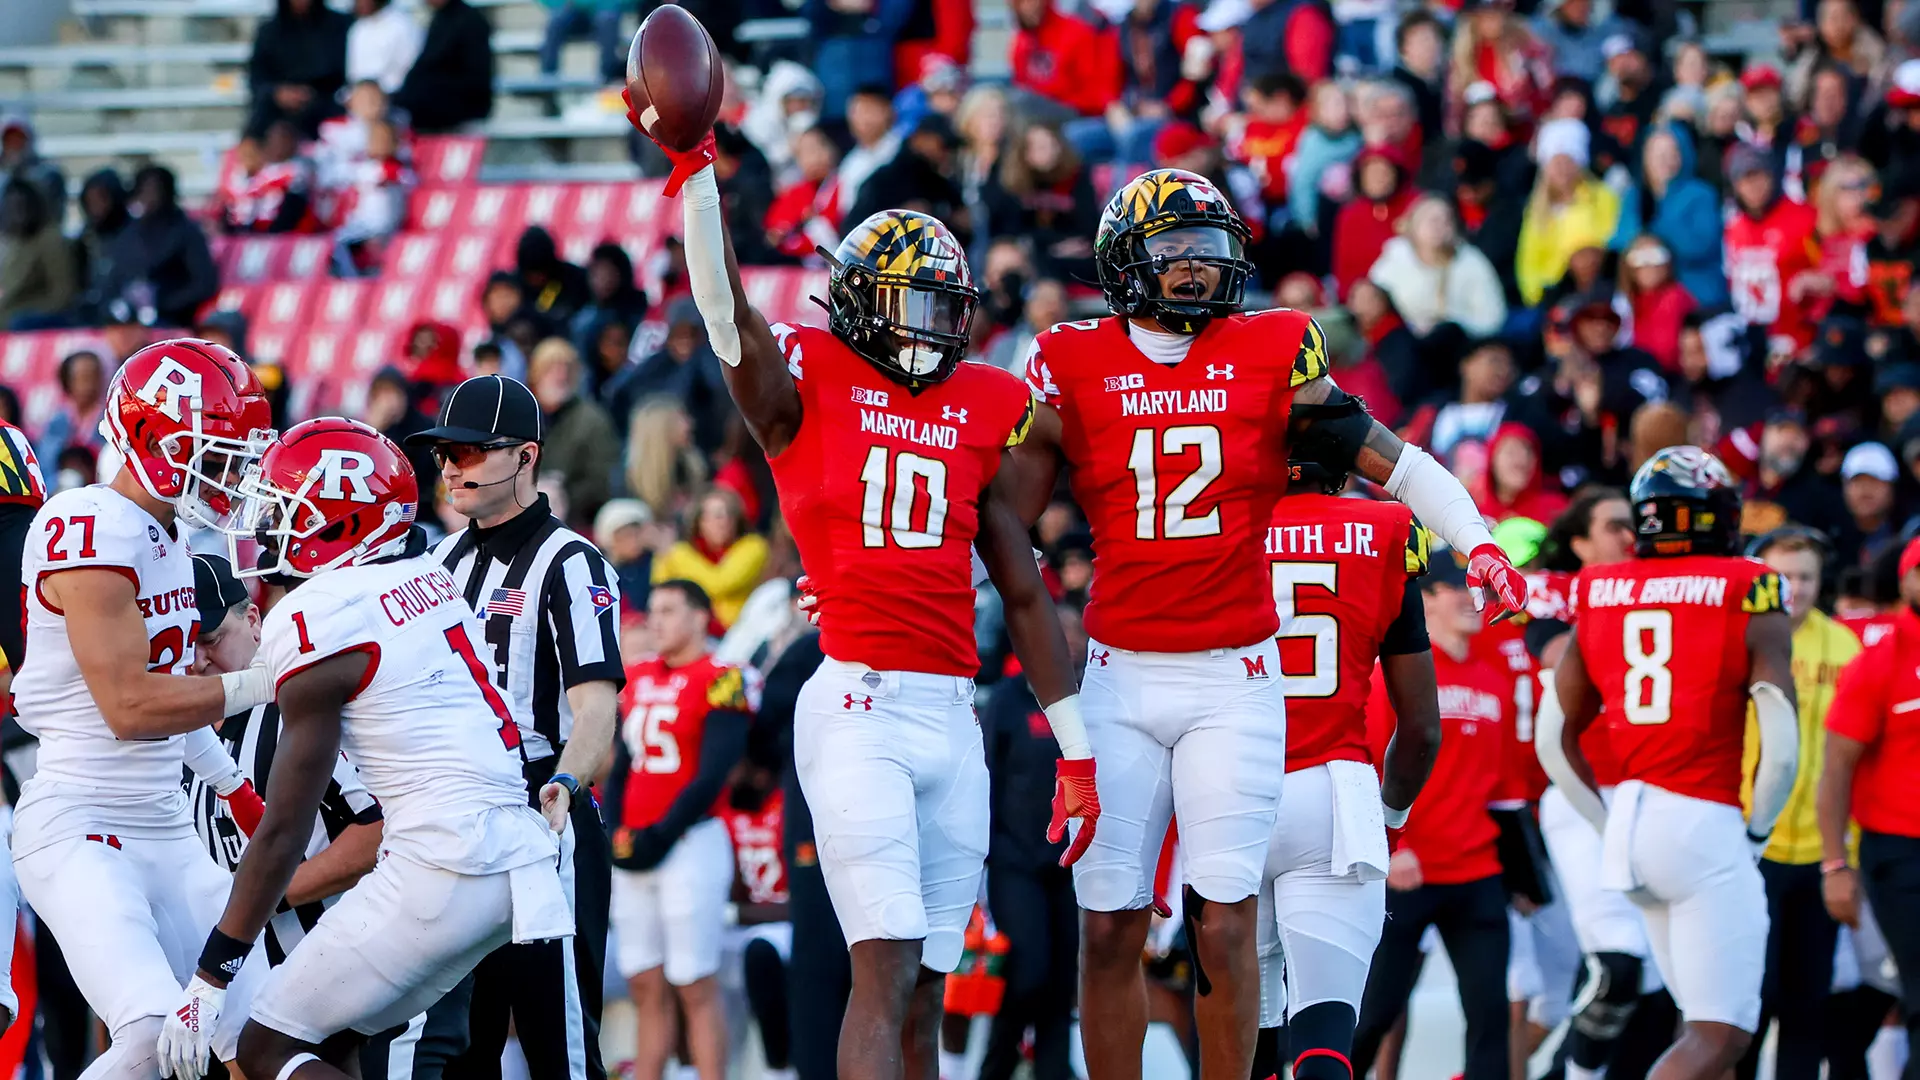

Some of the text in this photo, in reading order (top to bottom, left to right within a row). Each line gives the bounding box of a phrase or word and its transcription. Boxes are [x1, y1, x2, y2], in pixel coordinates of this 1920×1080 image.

[135, 355, 201, 423] R
[1121, 389, 1227, 416] MARYLAND
[860, 408, 958, 450] MARYLAND
[318, 448, 378, 504] R
[859, 445, 948, 549] 10
[1126, 424, 1224, 541] 12
[44, 515, 97, 562] 27
[1334, 522, 1379, 557] JR.
[1638, 575, 1728, 607] BROWN
[290, 610, 317, 655] 1
[1270, 560, 1340, 698] 5
[442, 620, 521, 752] 1
[1240, 655, 1269, 678] M
[1622, 608, 1674, 726] 8
[221, 833, 242, 865] U
[190, 996, 200, 1033] adidas
